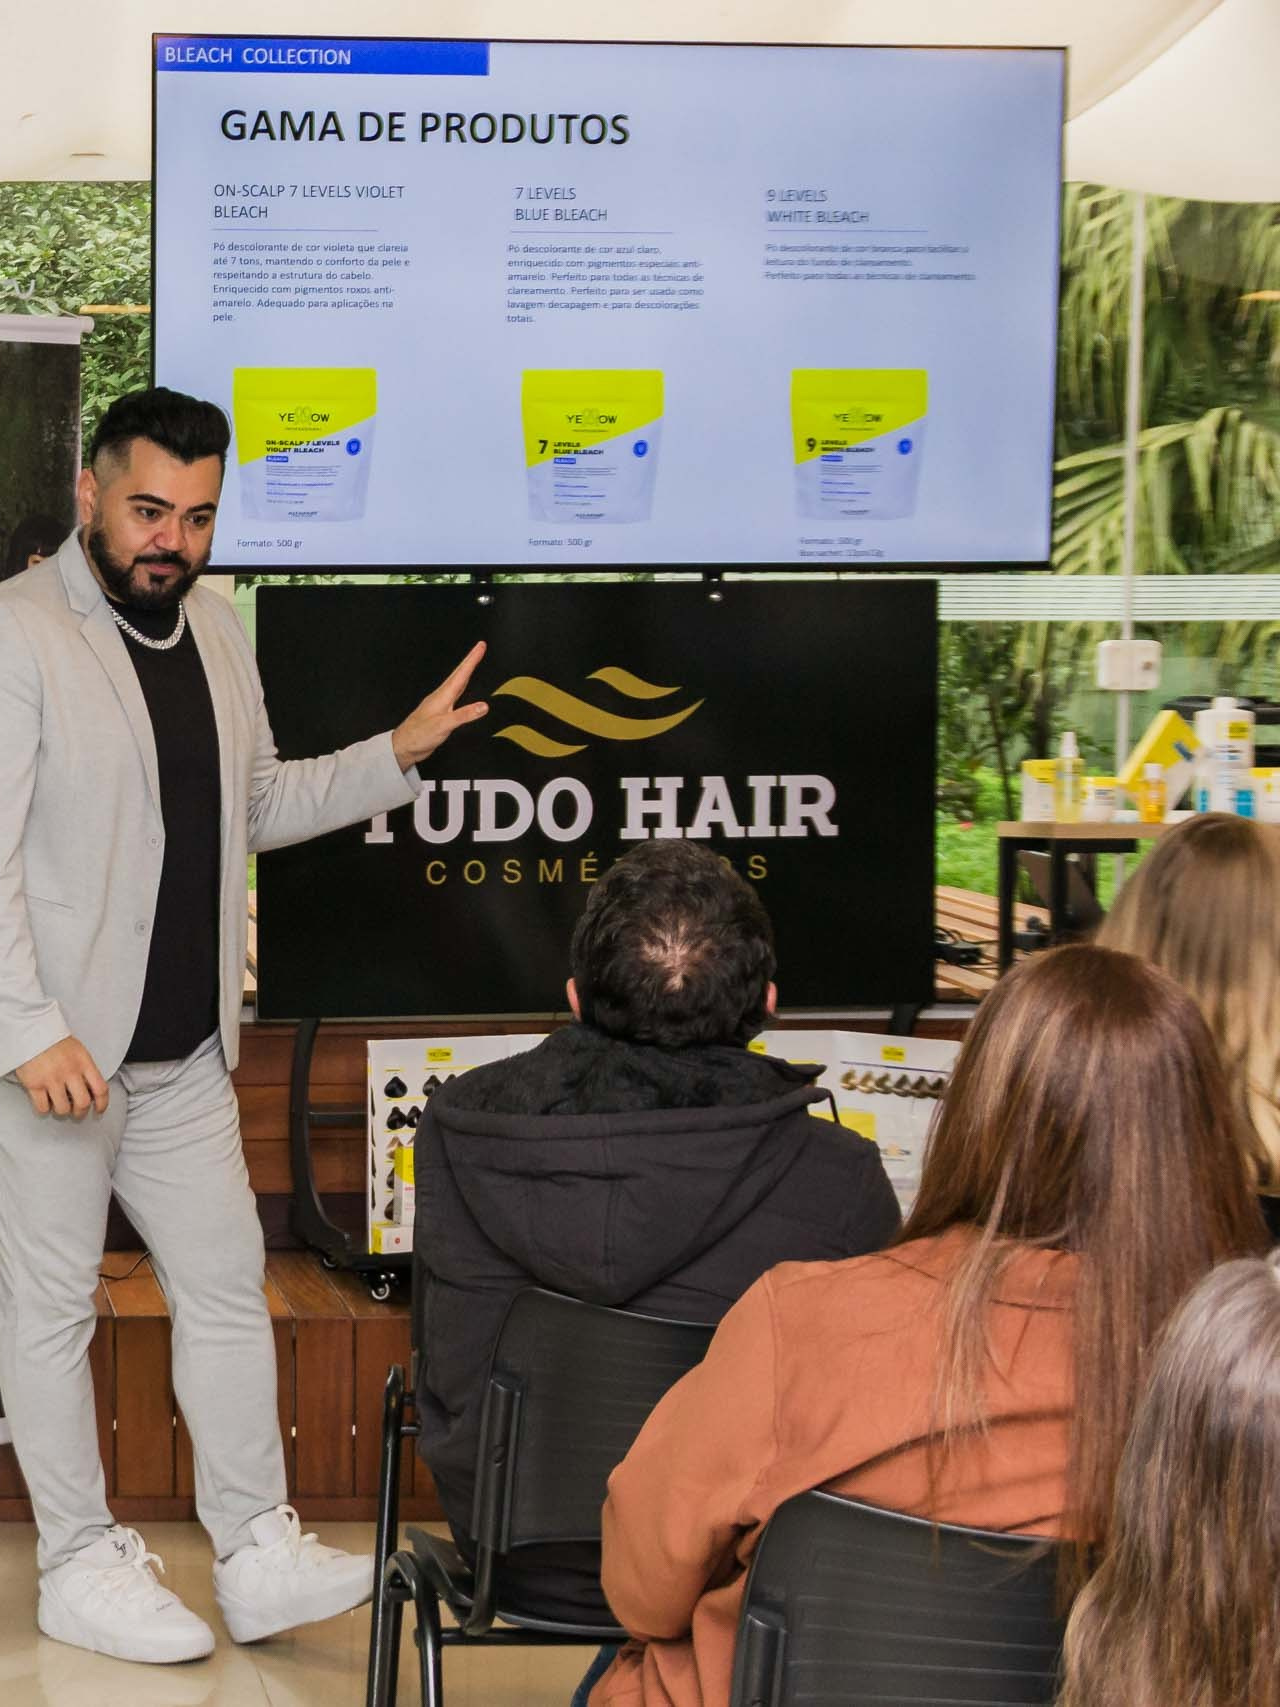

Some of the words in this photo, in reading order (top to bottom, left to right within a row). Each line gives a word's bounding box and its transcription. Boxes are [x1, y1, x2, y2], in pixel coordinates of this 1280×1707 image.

[165, 48, 233, 64] BLEACH
[243, 48, 352, 66] COLLECTION
[221, 109, 345, 142] GAMA
[359, 111, 406, 142] DE
[421, 111, 629, 145] PRODUTOS
[214, 184, 285, 199] ON-SCALP
[290, 185, 298, 199] 7
[302, 185, 352, 199] LEVELS
[356, 185, 405, 199] VIOLET
[516, 187, 524, 200] 7
[528, 187, 576, 200] LEVELS
[768, 190, 775, 202] 9
[779, 190, 828, 202] LEVELS
[214, 205, 268, 219] BLEACH
[515, 208, 549, 221] BLUE
[554, 208, 608, 222] BLEACH
[767, 211, 811, 223] WHITE
[816, 211, 869, 223] BLEACH
[213, 242, 225, 252] Pó
[228, 243, 288, 252] descolorante
[291, 243, 303, 252] de
[323, 244, 355, 252] violeta
[357, 245, 375, 253] que
[377, 244, 409, 252] clareia
[523, 245, 582, 254] descolorante
[213, 257, 228, 265] até
[265, 258, 314, 266] mantendo
[325, 258, 365, 266] conforto
[367, 258, 379, 266] da
[382, 258, 401, 267] pele
[213, 271, 269, 281] respeitando
[280, 272, 322, 280] estrutura
[325, 272, 337, 280] do
[213, 285, 269, 295] Enriquecido
[294, 286, 343, 295] pigmentos
[257, 300, 305, 309] Adequado
[331, 300, 379, 309] aplicações
[539, 440, 548, 454] 7
[806, 437, 817, 452] 9
[276, 540, 292, 548] 500
[620, 774, 839, 839] HAIR
[426, 852, 768, 885] COSMÉS
